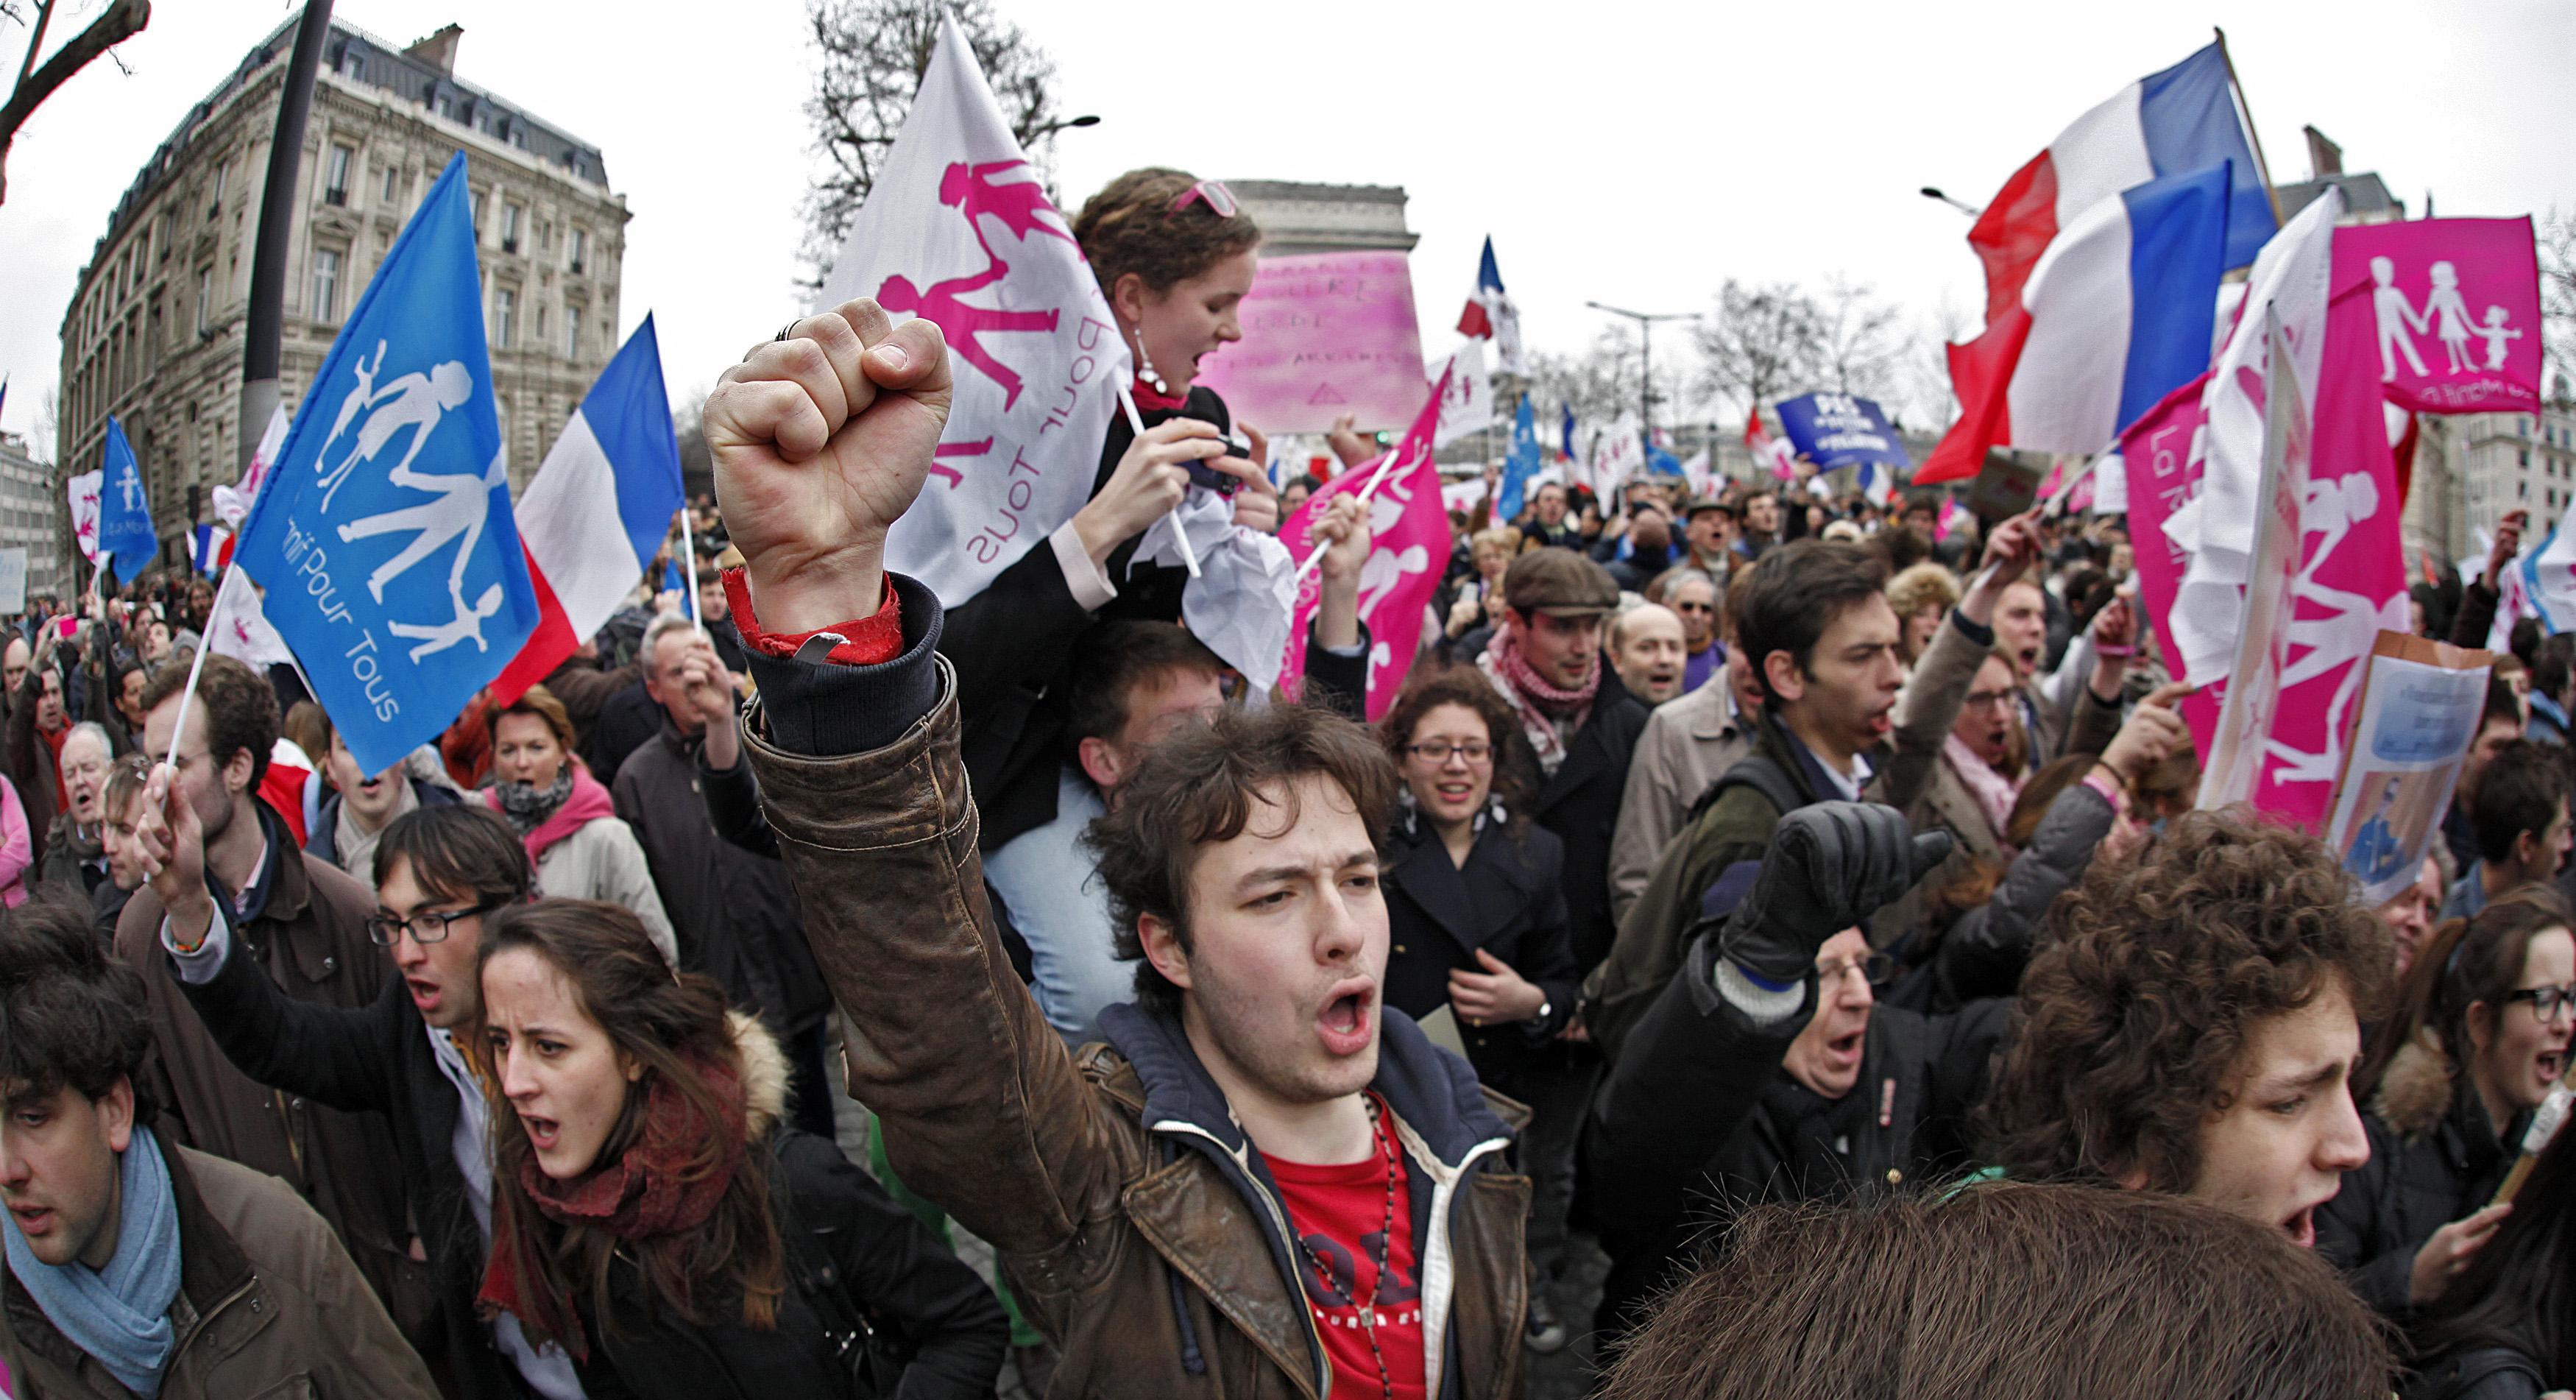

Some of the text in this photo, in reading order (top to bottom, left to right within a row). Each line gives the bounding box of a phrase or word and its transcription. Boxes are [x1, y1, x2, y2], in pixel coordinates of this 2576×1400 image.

[2150, 424, 2179, 478] La
[296, 547, 353, 623] Pour
[344, 628, 400, 722] Tous
